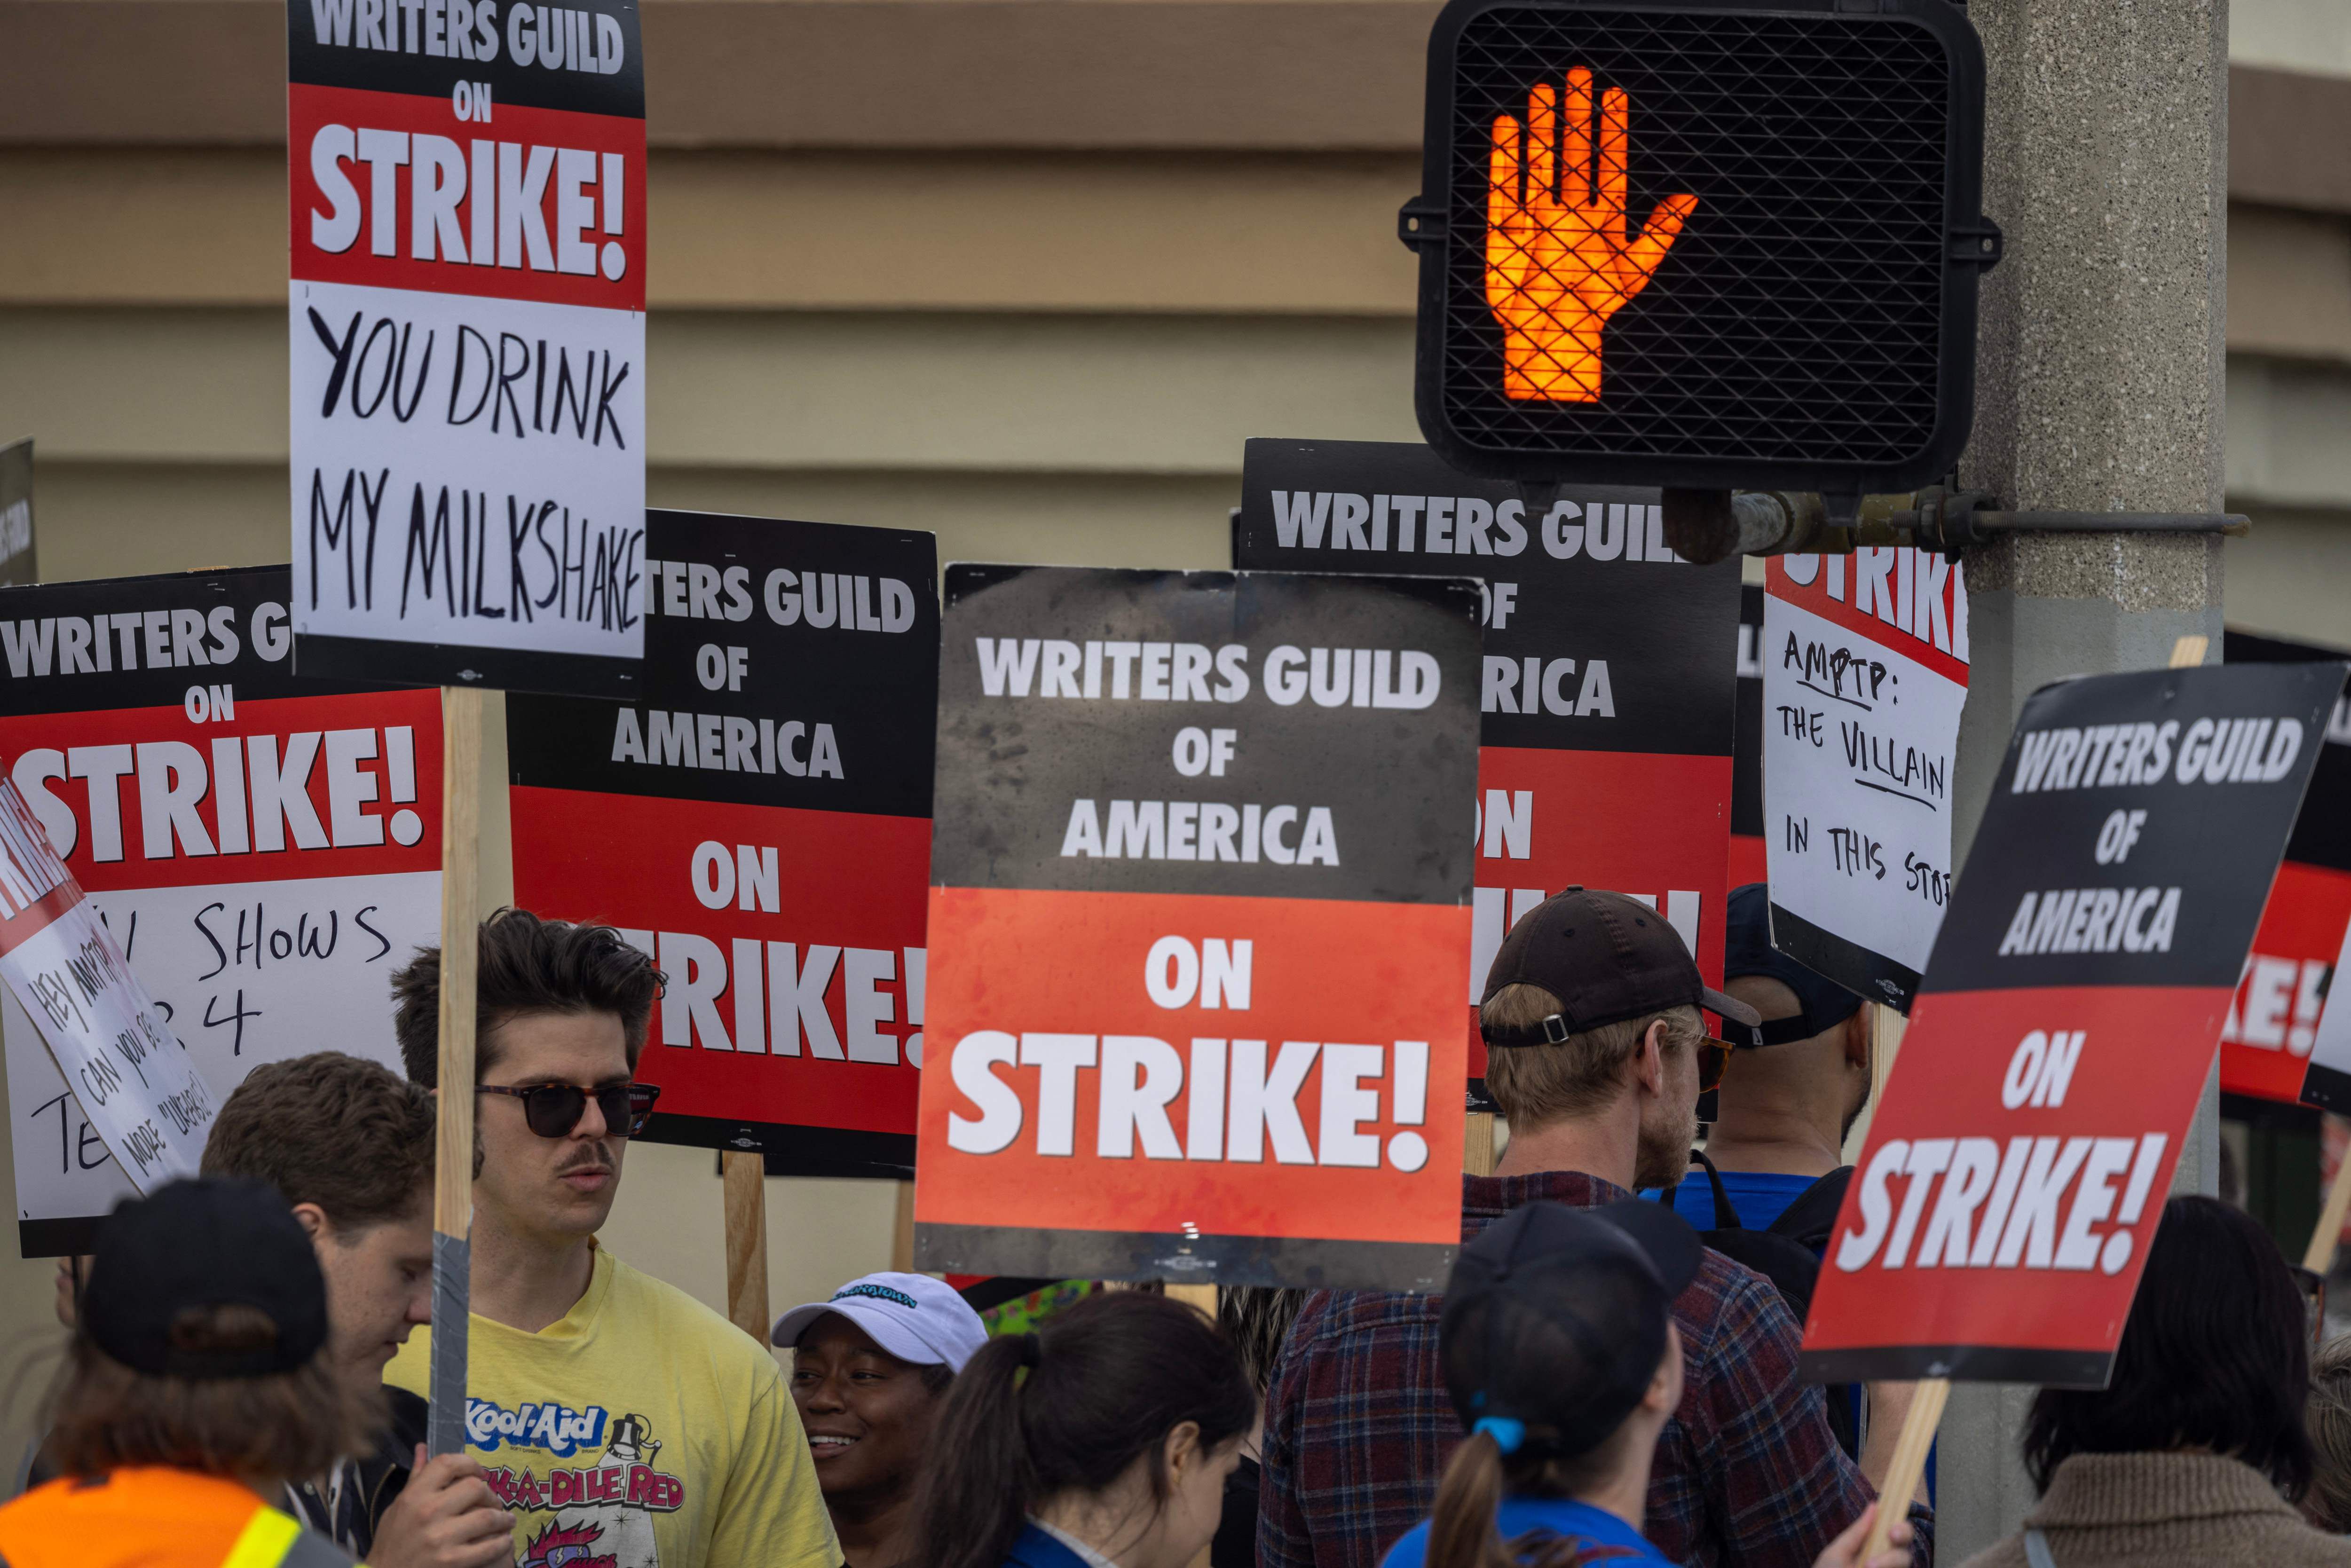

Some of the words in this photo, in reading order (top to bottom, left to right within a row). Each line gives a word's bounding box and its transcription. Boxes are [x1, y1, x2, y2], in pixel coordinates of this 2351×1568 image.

[311, 0, 499, 62] WRITERS
[507, 3, 624, 75] GUILD
[453, 79, 492, 123] ON
[311, 124, 627, 283] STRIKE!
[307, 305, 434, 423] YOU
[447, 323, 629, 450] DRINK
[310, 468, 390, 612] MY
[400, 482, 645, 633] MILKSHAKE
[1271, 489, 1528, 557] WRITERS
[1541, 500, 1693, 563] GUIL
[764, 568, 915, 634] GUILD
[1482, 582, 1518, 630] F
[0, 606, 240, 678] WRITERS
[696, 643, 749, 692] OF
[976, 637, 1251, 704] WRITERS
[1262, 645, 1442, 710] GUILD
[1783, 630, 1898, 705] AMPTP:
[184, 684, 235, 724] ON
[611, 707, 844, 780] AMERICA
[1172, 726, 1237, 777] OF
[1777, 705, 1824, 747] THE
[1841, 720, 1945, 800] VILLAIN
[2011, 719, 2181, 795] WRITERS
[2175, 717, 2304, 785] GUILD
[11, 725, 425, 863] STRIKE!
[1474, 788, 1533, 860] N
[1060, 798, 1341, 867] AMERICA
[1786, 814, 1808, 853] IN
[1827, 827, 1886, 881] THIS
[2094, 809, 2148, 866] OF
[691, 840, 781, 914] ON
[194, 902, 391, 981] SHOWS
[1997, 886, 2182, 957] AMERICA
[28, 970, 90, 1033] HEY
[578, 924, 928, 1071] RIKE!
[1144, 934, 1254, 1010] ON
[80, 1048, 122, 1106] CAN
[115, 1028, 149, 1089] YOU
[136, 1010, 161, 1051] BE
[203, 989, 263, 1057] 4
[947, 1030, 1431, 1173] STRIKE!
[2001, 1030, 2087, 1110] ON
[121, 1118, 166, 1177] MORE
[1835, 1132, 2169, 1276] STRIKE!
[465, 1398, 607, 1455] Kool-Aid
[481, 1464, 623, 1511] K-A-DILE
[627, 1463, 685, 1511] RED
